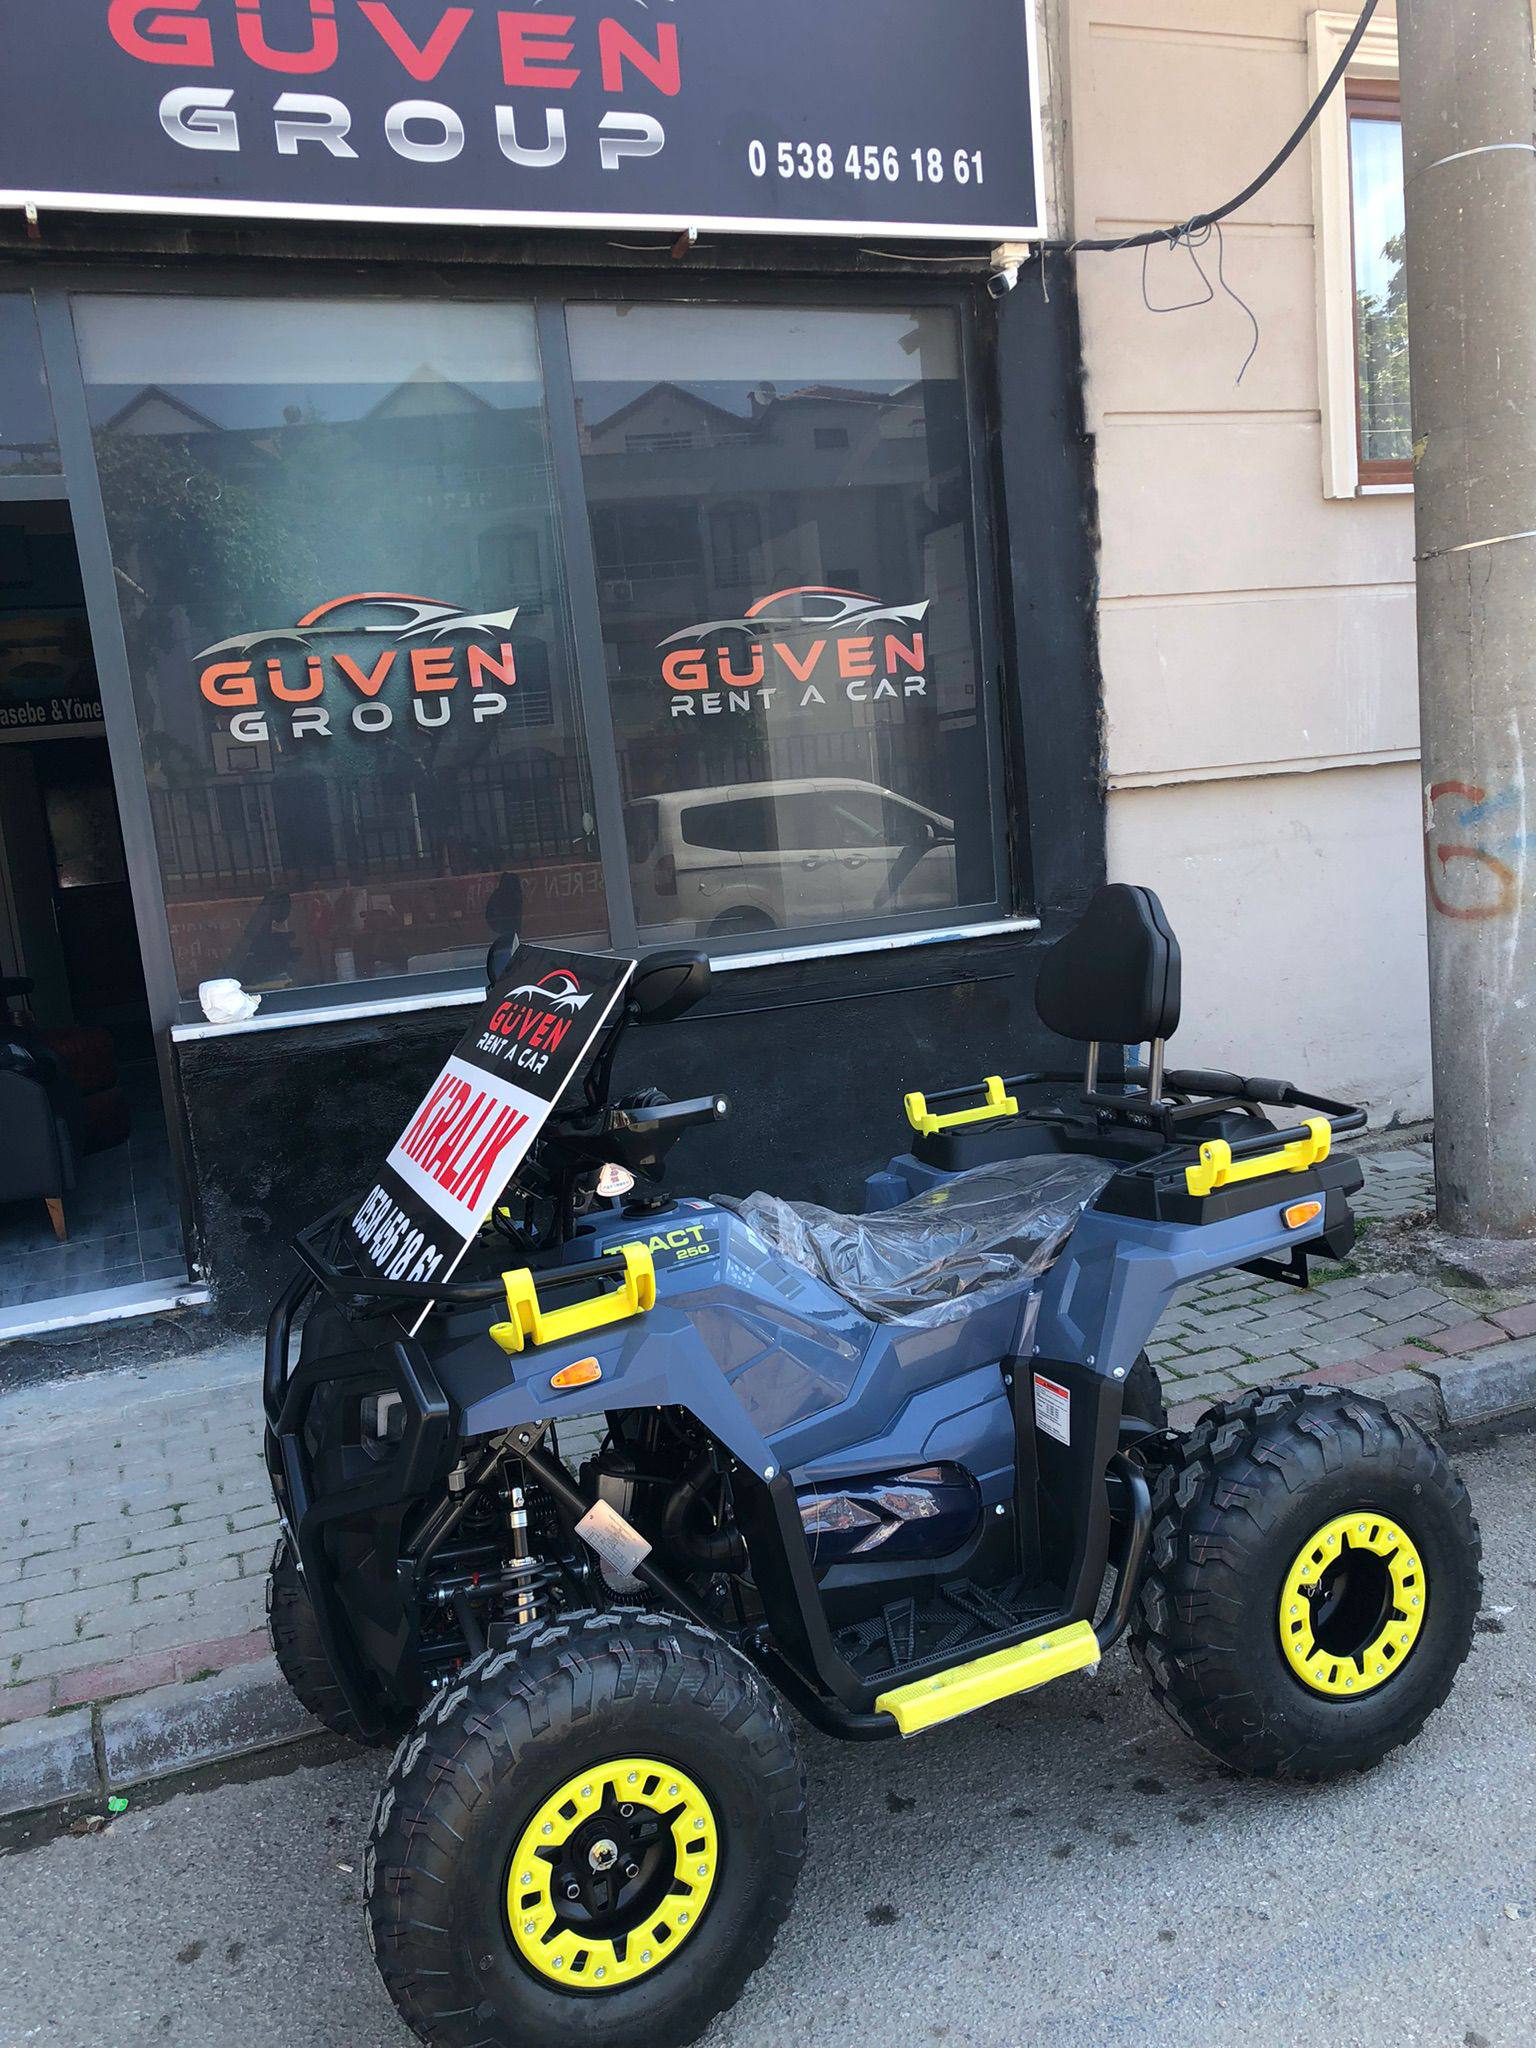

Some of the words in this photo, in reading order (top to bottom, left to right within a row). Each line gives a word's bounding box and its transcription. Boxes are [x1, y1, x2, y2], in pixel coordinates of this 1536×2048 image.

[108, 0, 682, 97] GÜVEN
[158, 86, 666, 171] GROUP
[748, 139, 767, 178] 0
[777, 141, 835, 181] 538
[844, 144, 900, 183] 456
[911, 147, 944, 184] 18
[953, 149, 984, 185] 61
[200, 642, 517, 707] GÜVEN
[661, 632, 926, 691] GÜVEN
[229, 692, 508, 742] GROUP
[670, 687, 777, 718] RENT
[799, 684, 827, 707] A
[846, 675, 927, 702] CAR
[476, 1031, 509, 1056] RENT
[503, 1043, 519, 1062] A
[517, 1048, 549, 1075] CAR
[488, 1001, 573, 1053] GÜVEN
[400, 1072, 530, 1212] KİRALIK
[352, 1184, 393, 1245] 0538
[368, 1206, 411, 1267] 456
[603, 1224, 705, 1256] ACT
[383, 1228, 425, 1280] 18
[406, 1244, 444, 1283] 61
[676, 1244, 710, 1260] 250
